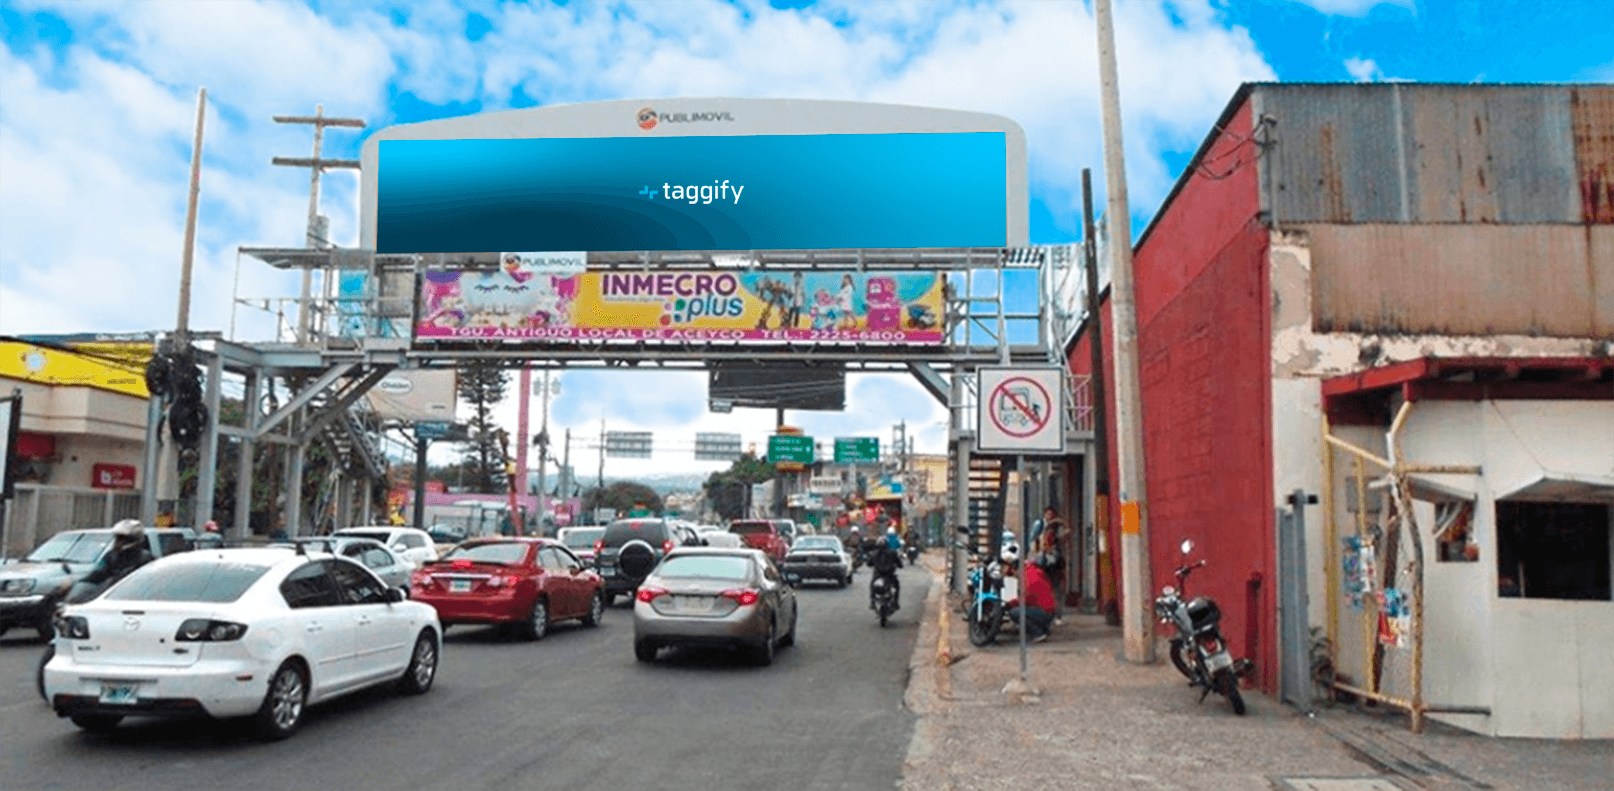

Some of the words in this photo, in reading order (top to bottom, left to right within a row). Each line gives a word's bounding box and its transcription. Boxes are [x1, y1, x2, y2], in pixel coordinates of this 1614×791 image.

[660, 111, 735, 123] PUBLIMOVIL
[662, 179, 745, 205] taggify
[522, 257, 582, 267] PUBLIMOVIL
[603, 274, 737, 296] INMECRO
[686, 295, 743, 322] plus
[451, 327, 488, 337] TGU.
[494, 327, 573, 337] ANTIGUO
[579, 328, 638, 338] LOCAL
[643, 329, 665, 338] DE
[671, 329, 744, 339] ACEYCO
